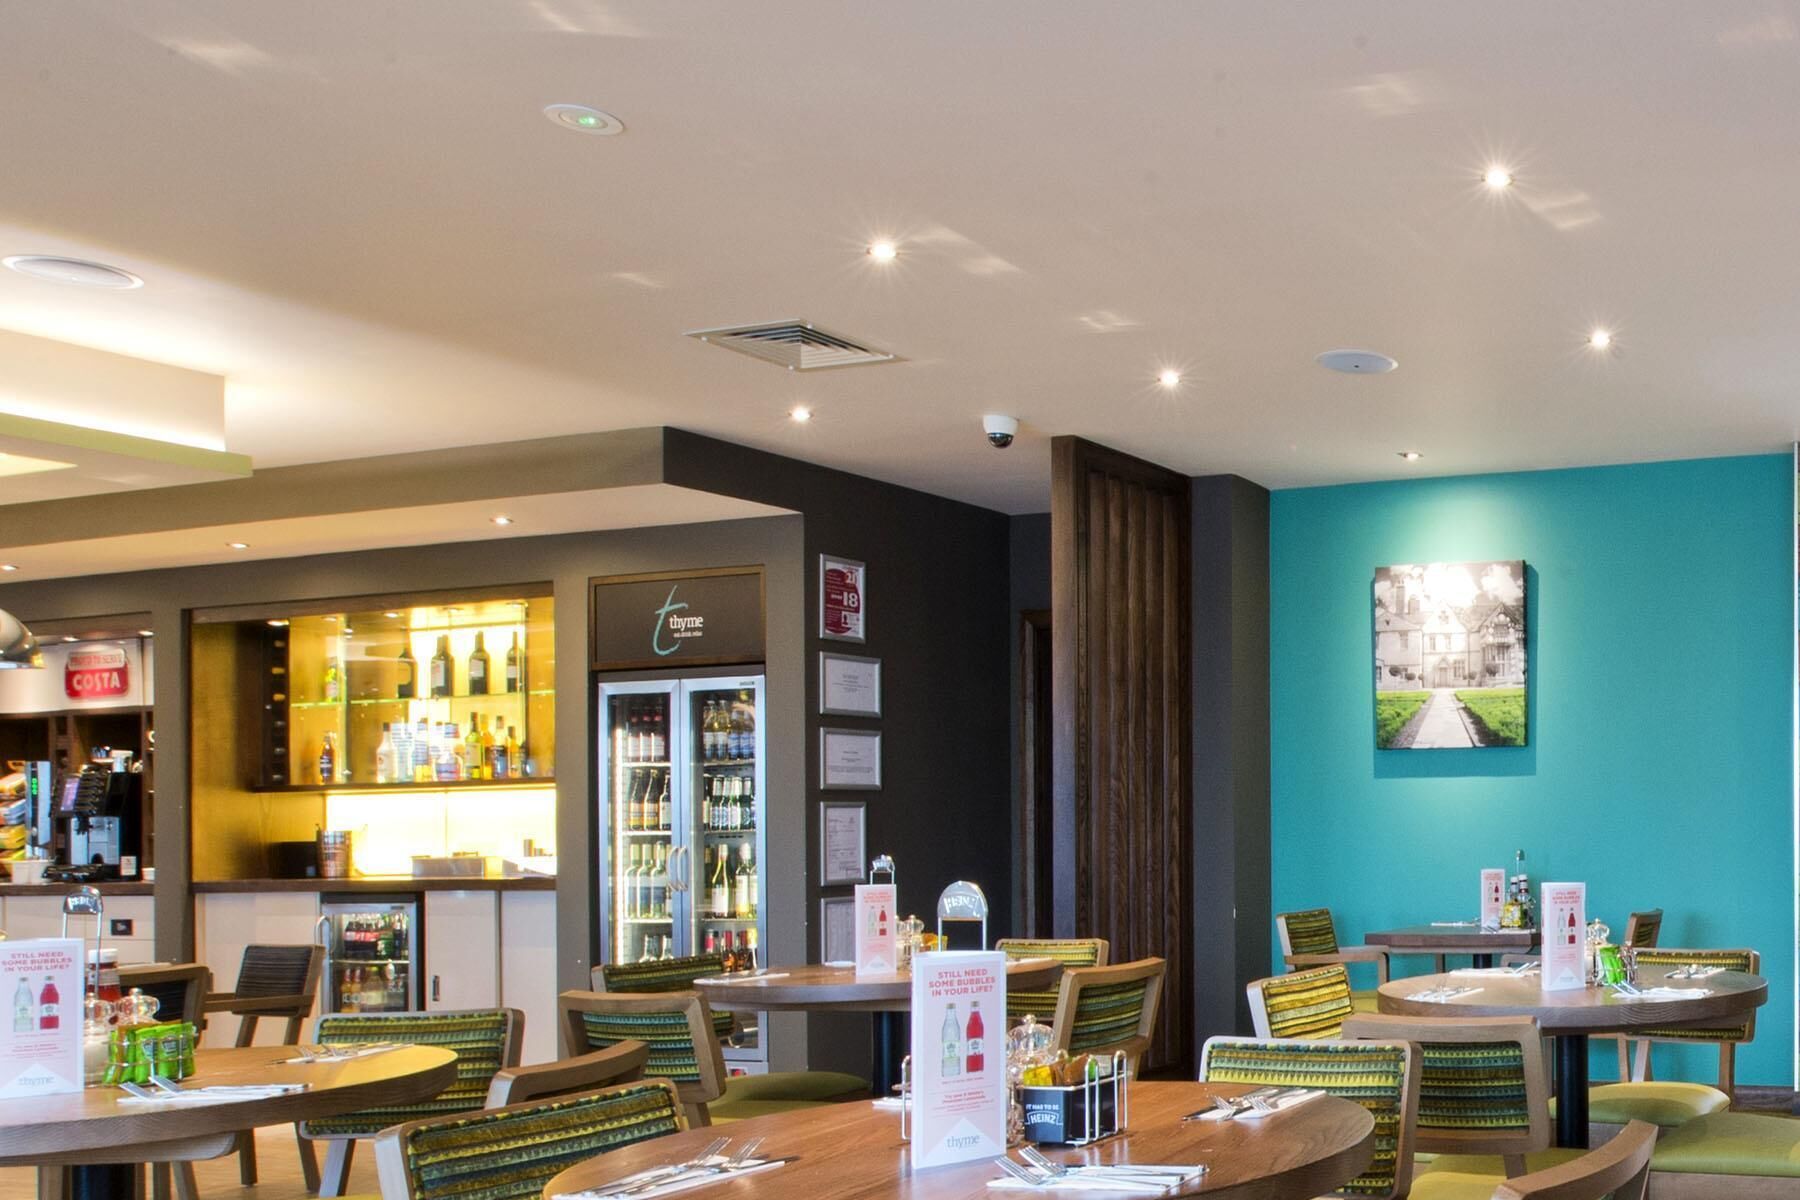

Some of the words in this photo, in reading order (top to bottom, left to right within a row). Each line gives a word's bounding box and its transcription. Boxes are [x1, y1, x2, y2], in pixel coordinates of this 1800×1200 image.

[843, 592, 859, 608] 18
[668, 614, 704, 632] thyme
[72, 671, 121, 692] COSTA
[938, 971, 962, 980] STILL
[964, 968, 988, 977] NEED
[928, 979, 955, 988] SOME
[956, 976, 996, 986] BUBBLES
[931, 989, 942, 997] IN
[944, 987, 969, 996] YOUR
[970, 985, 993, 994] LIFE?
[1030, 1113, 1057, 1125] HEINZ
[946, 1134, 980, 1150] thyme
